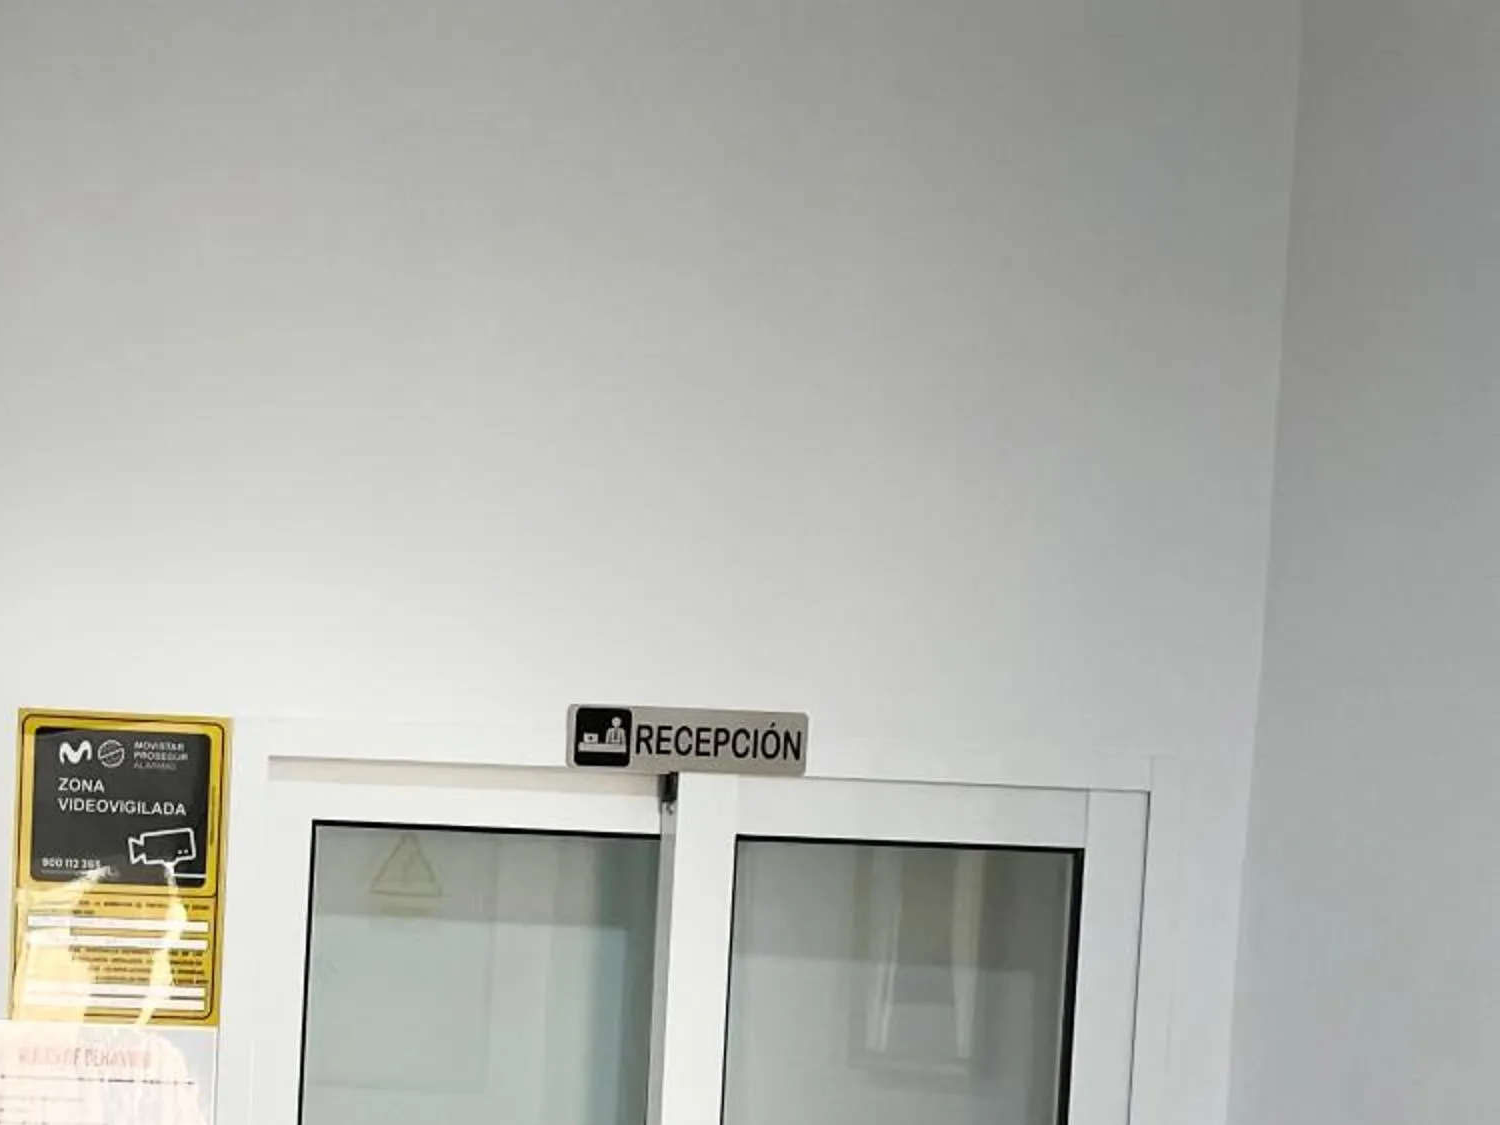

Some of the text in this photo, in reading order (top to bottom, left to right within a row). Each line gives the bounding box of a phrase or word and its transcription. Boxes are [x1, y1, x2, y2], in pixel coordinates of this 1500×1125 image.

[635, 722, 802, 761] RECEPCIÓN
[58, 777, 105, 793] ZONA
[58, 797, 187, 817] VIDEOVIGILADA
